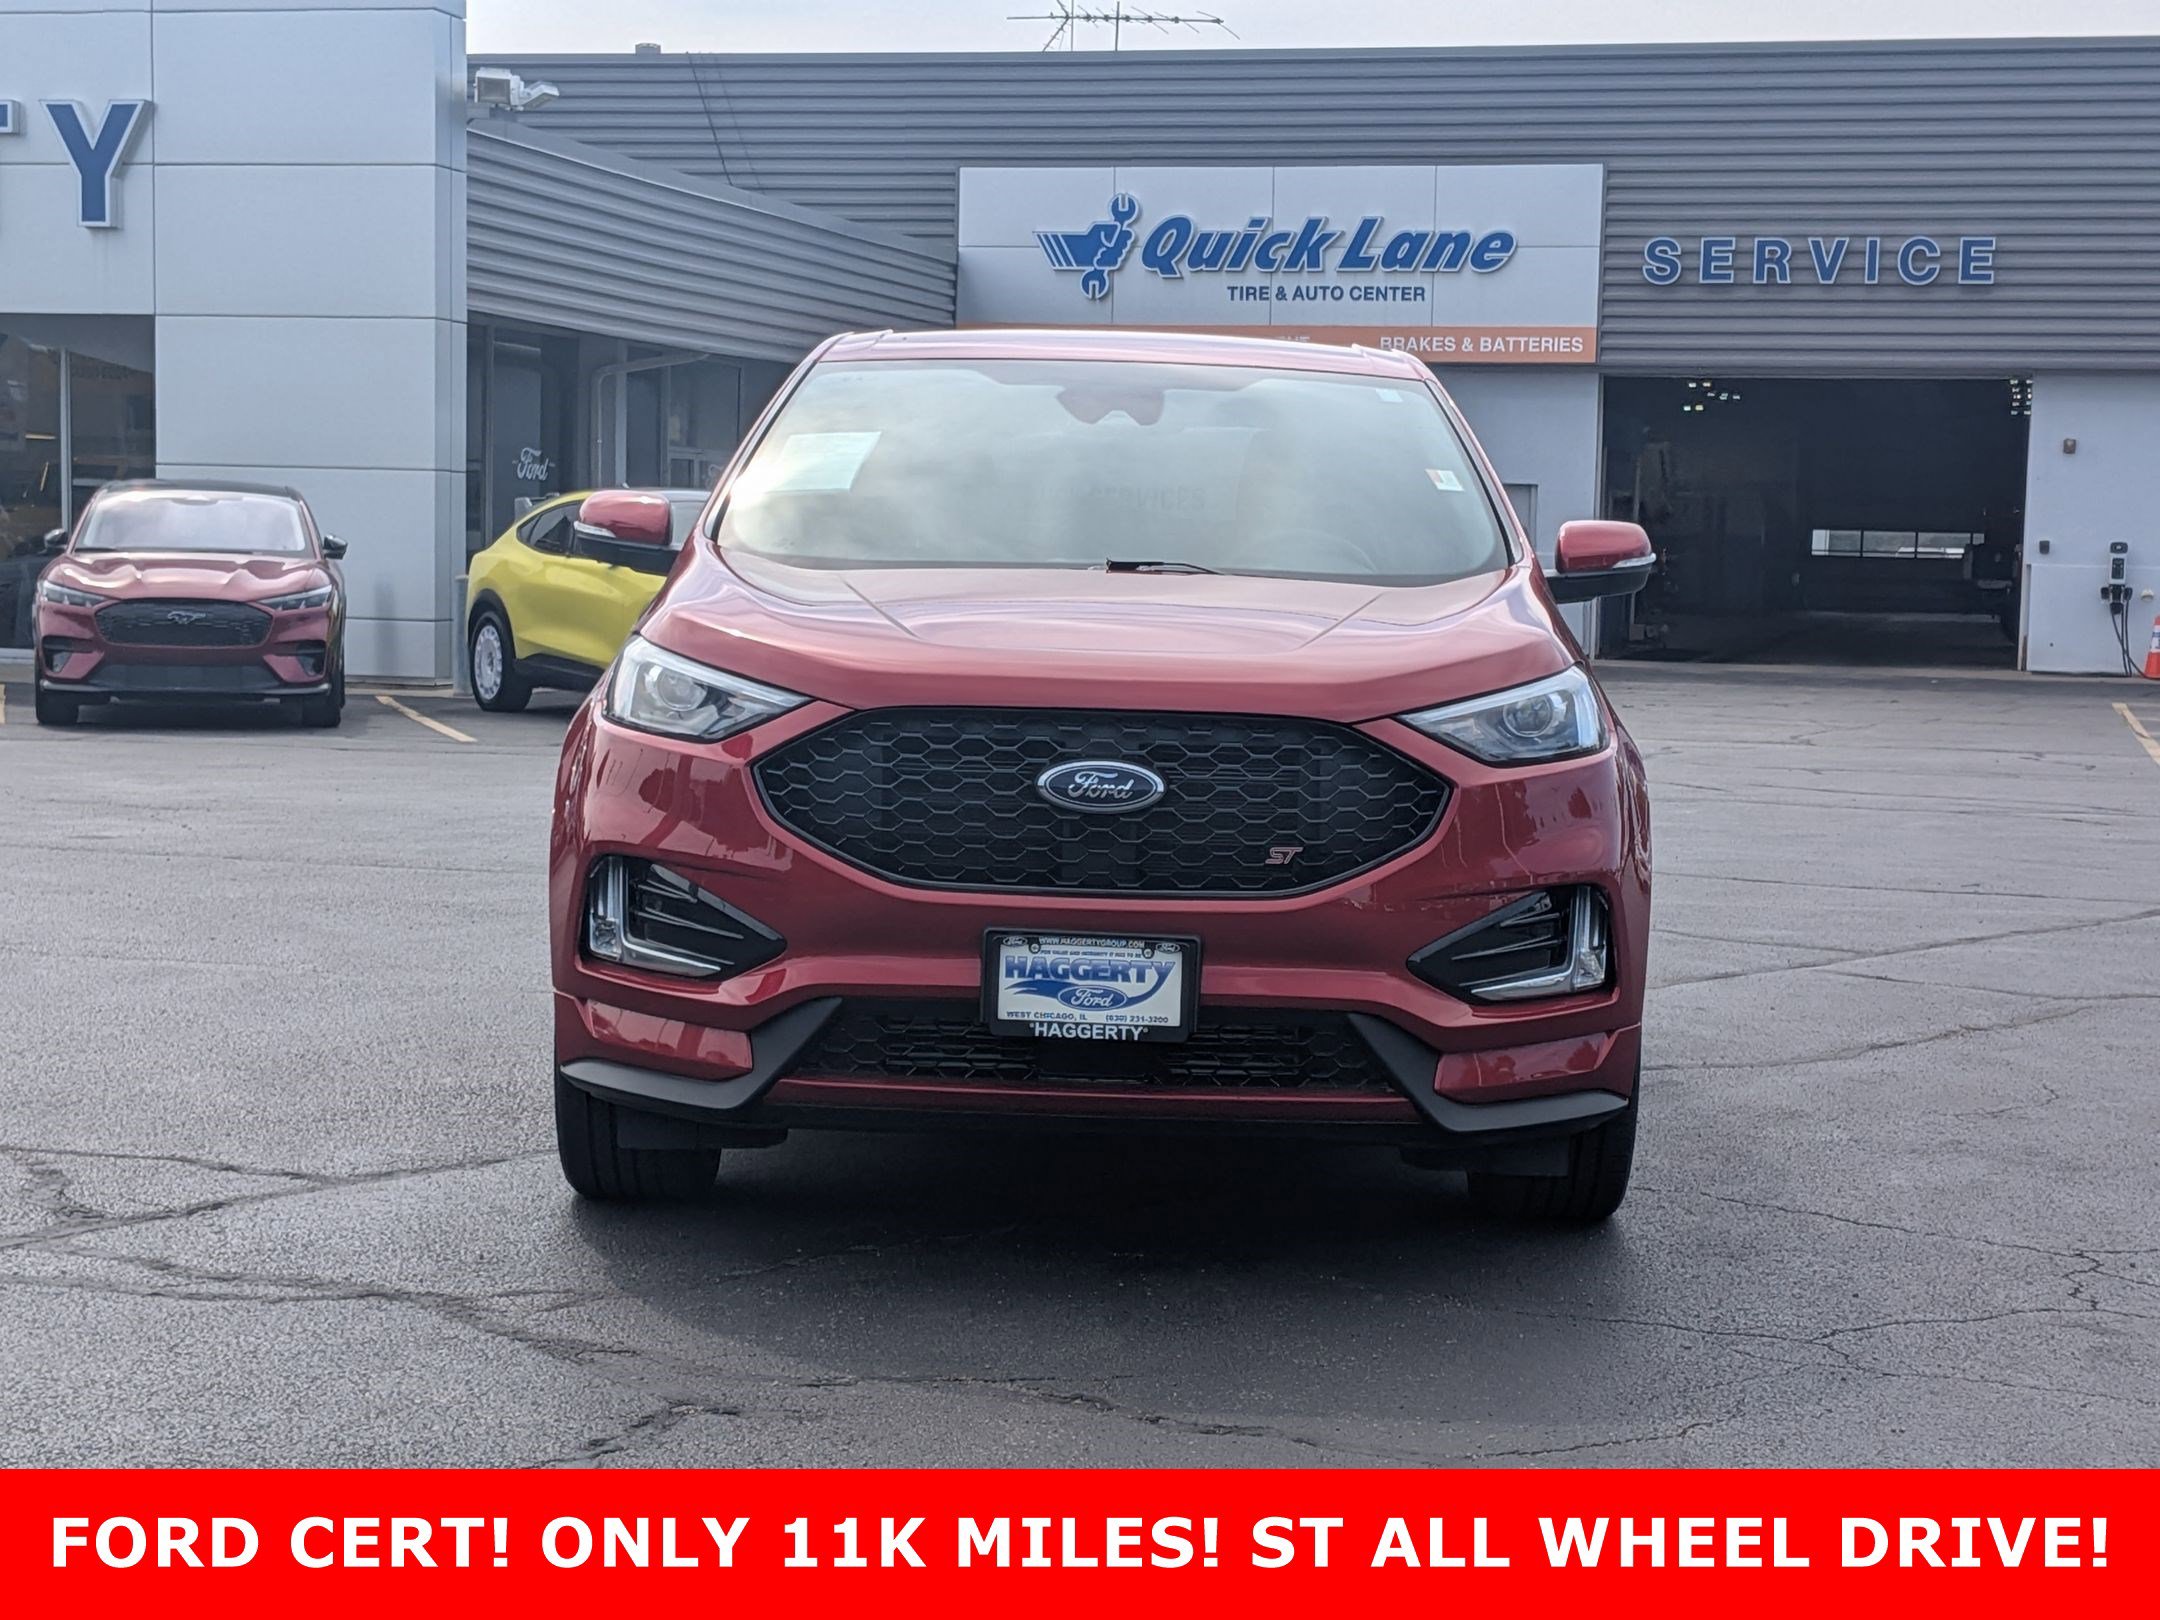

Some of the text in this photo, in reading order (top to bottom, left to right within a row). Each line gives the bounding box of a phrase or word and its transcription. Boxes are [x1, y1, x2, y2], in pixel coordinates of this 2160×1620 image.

[0, 99, 152, 231] Y
[1140, 214, 1517, 279] Quick Lane
[1642, 236, 1996, 285] SERVICE
[1227, 286, 1426, 302] TIRE & AUTO CENTER
[1380, 336, 1584, 353] BRAKES & BATTERIES
[517, 447, 548, 481] Ford
[1067, 771, 1133, 800] Ford
[1265, 846, 1303, 865] ST
[1004, 955, 1175, 984] HAGGERTY
[1070, 988, 1113, 1008] Ford
[1006, 1011, 1087, 1021] WEST CHICAGO, IL
[1034, 1022, 1144, 1041] HAGGERTY
